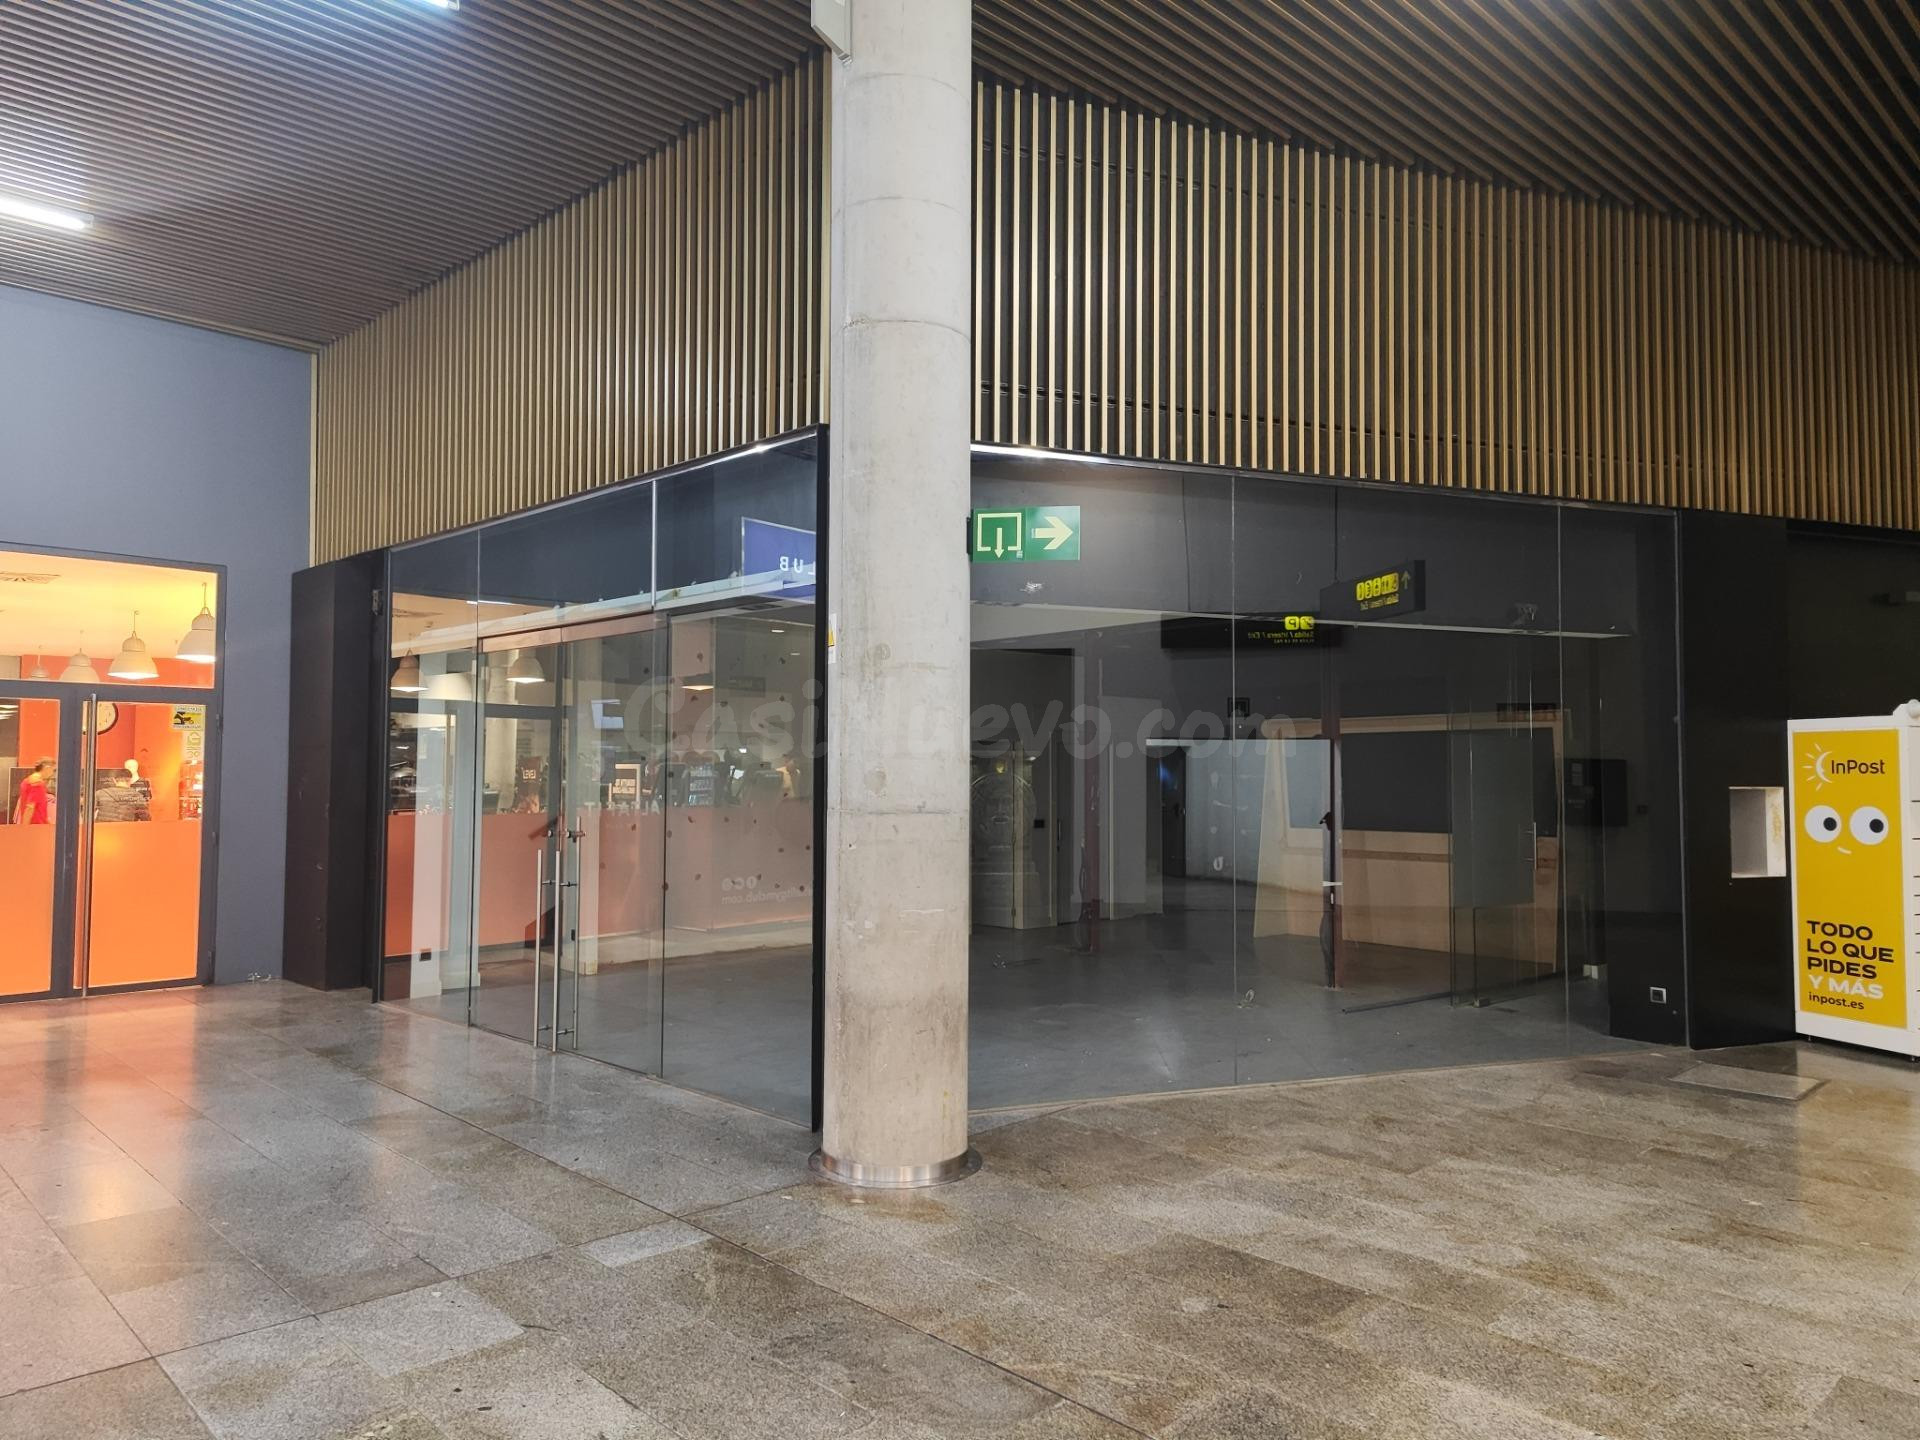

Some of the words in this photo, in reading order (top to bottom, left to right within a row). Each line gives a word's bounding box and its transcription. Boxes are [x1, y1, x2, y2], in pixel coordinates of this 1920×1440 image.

[1831, 759, 1885, 775] InPost
[1806, 920, 1873, 941] TODO
[1807, 938, 1837, 955] LO
[1842, 943, 1895, 963] QUE
[1807, 956, 1877, 980] PIDES
[1808, 974, 1824, 990] Y
[1828, 977, 1885, 1000] MÁS
[1808, 992, 1865, 1010] inpost.es
